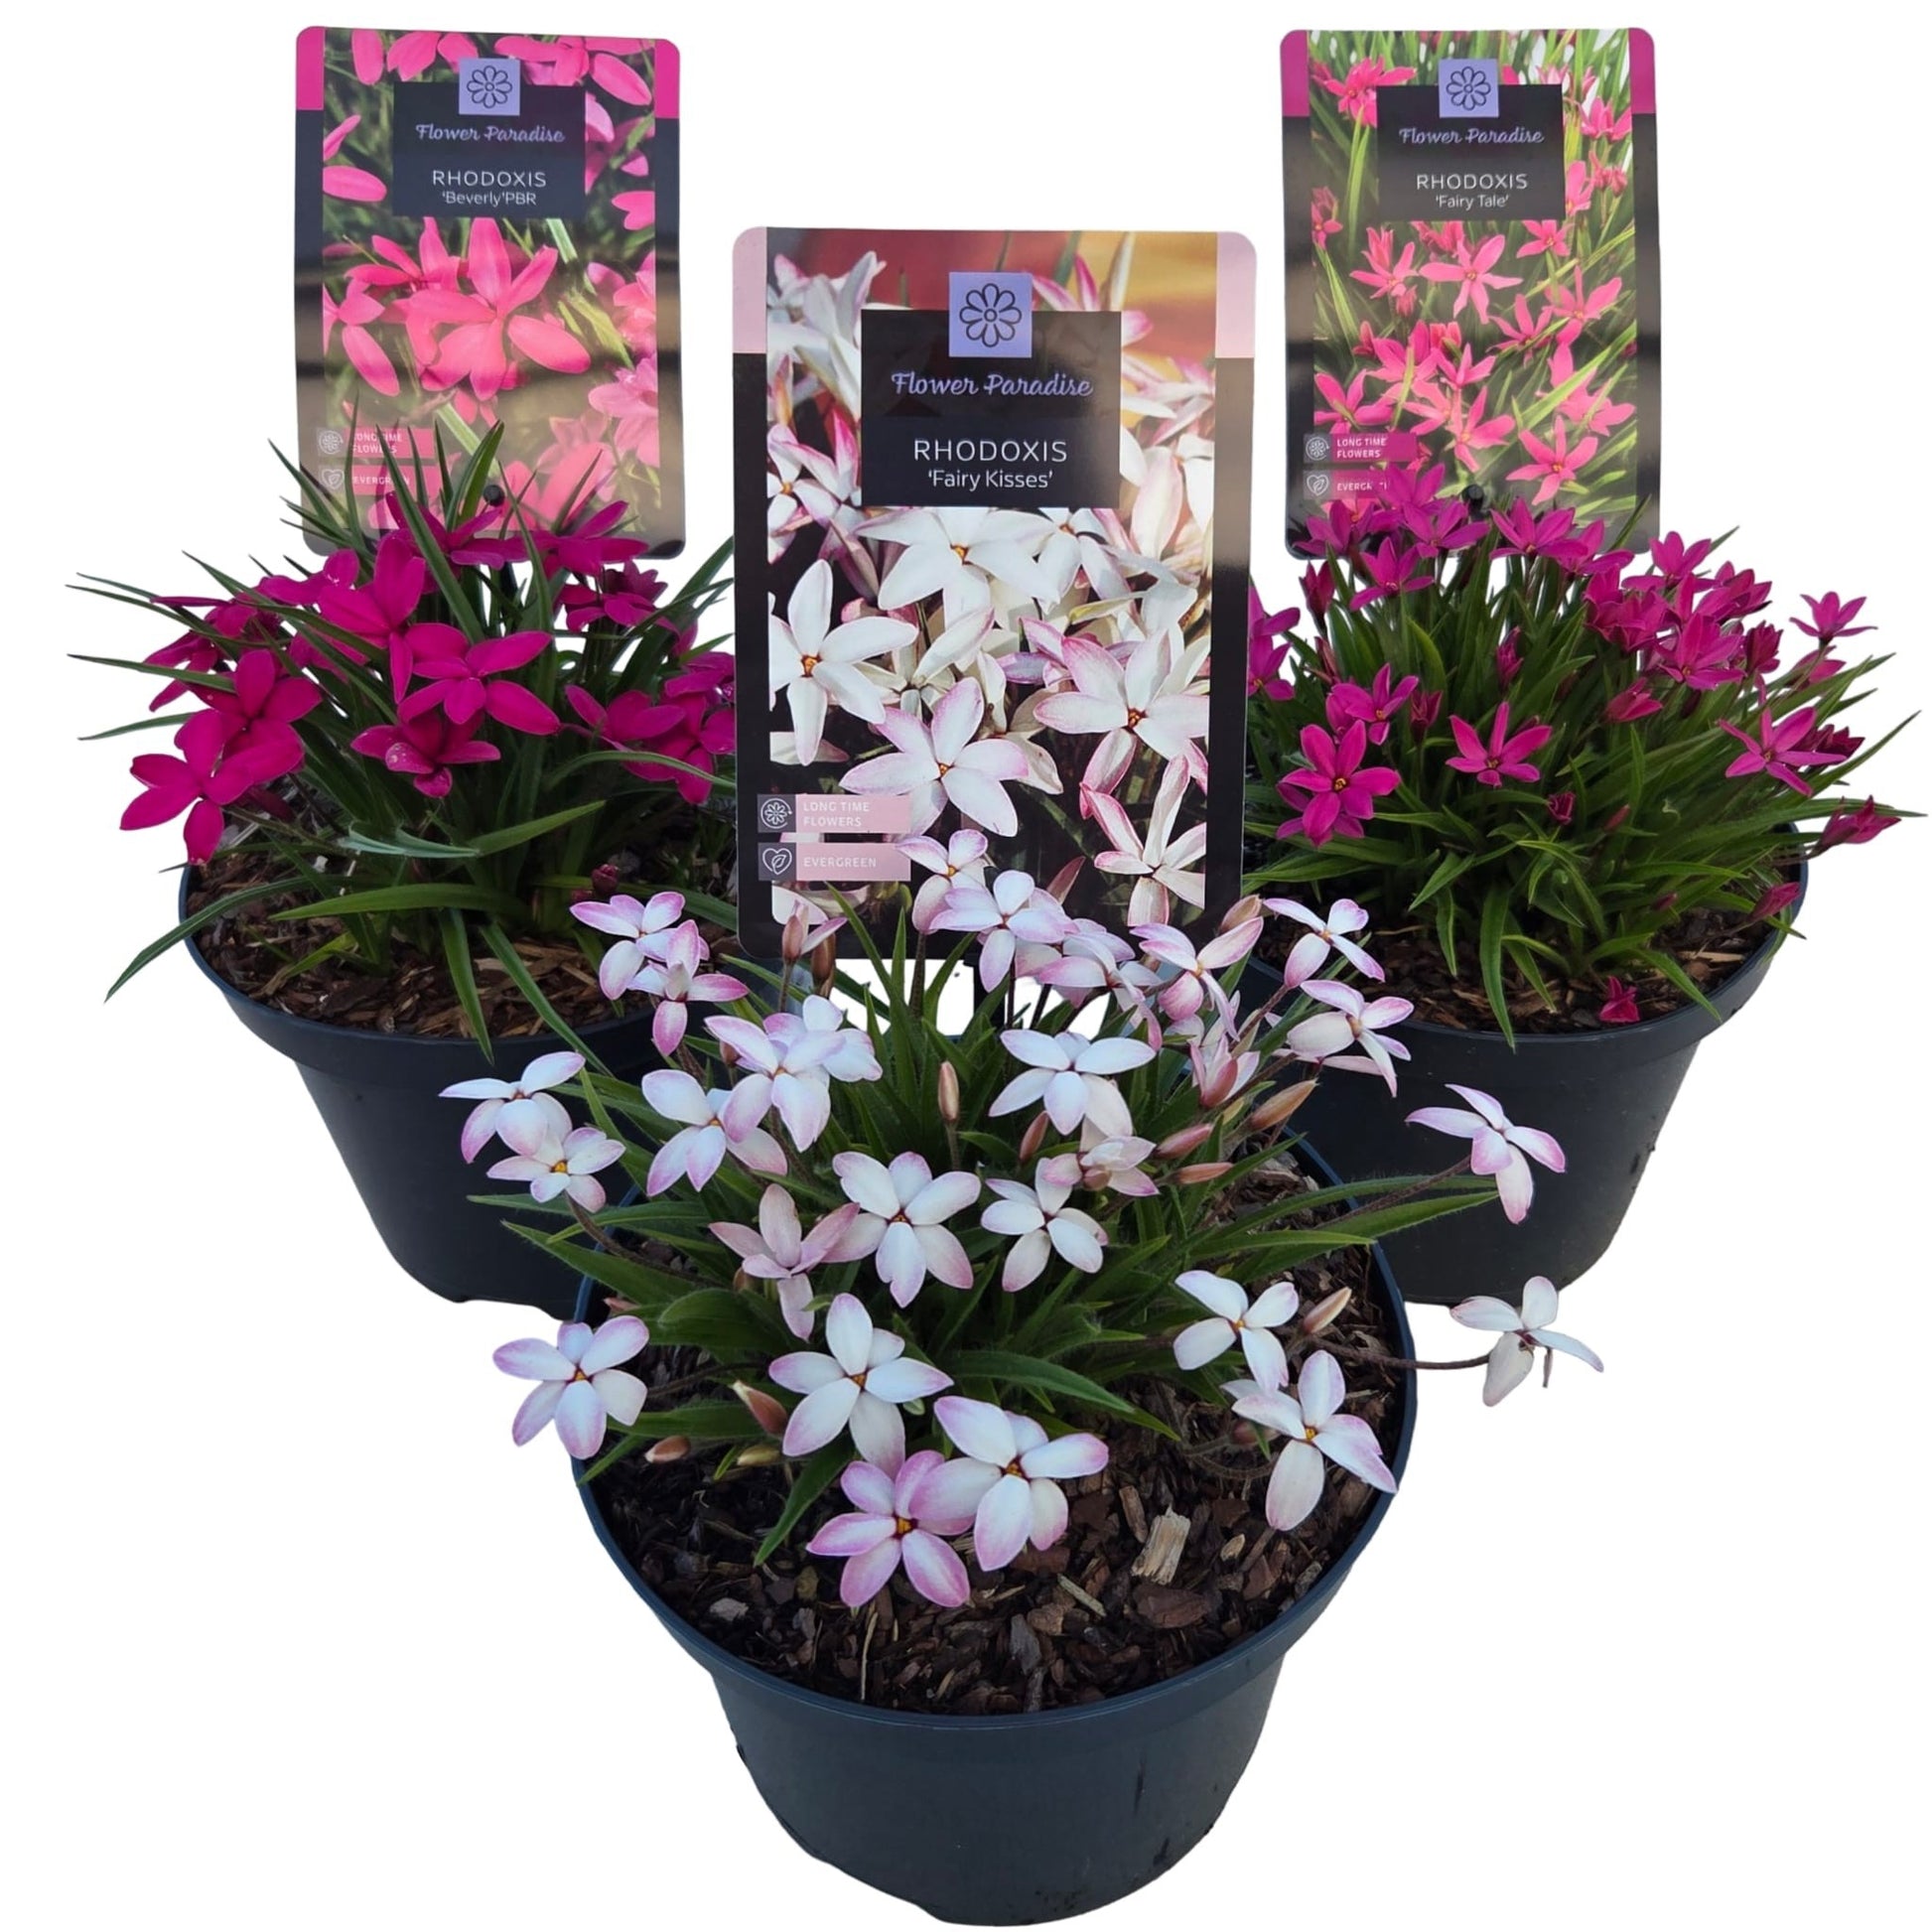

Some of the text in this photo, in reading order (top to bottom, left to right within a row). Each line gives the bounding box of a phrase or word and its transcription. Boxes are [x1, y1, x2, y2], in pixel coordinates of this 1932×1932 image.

[415, 123, 565, 143] Flower Paradise
[1398, 126, 1545, 144] Flower Paradise
[432, 170, 547, 188] RHODOXIS
[1416, 173, 1529, 190] RHODOXIS
[1436, 195, 1509, 211] 'Fairy Tale'
[891, 370, 1093, 397] Flower Paradise
[354, 432, 378, 442] ONG
[1336, 437, 1387, 447] LONG TIME
[352, 444, 398, 454] FLOWES
[913, 439, 1067, 463] RHODOXIS
[1336, 449, 1381, 459] FLOWERS
[927, 469, 1053, 492] 'Fairy Kisses'
[803, 801, 870, 812] LONG TIME
[803, 816, 862, 827] FLOWERS
[803, 857, 877, 868] EVERGREEN
